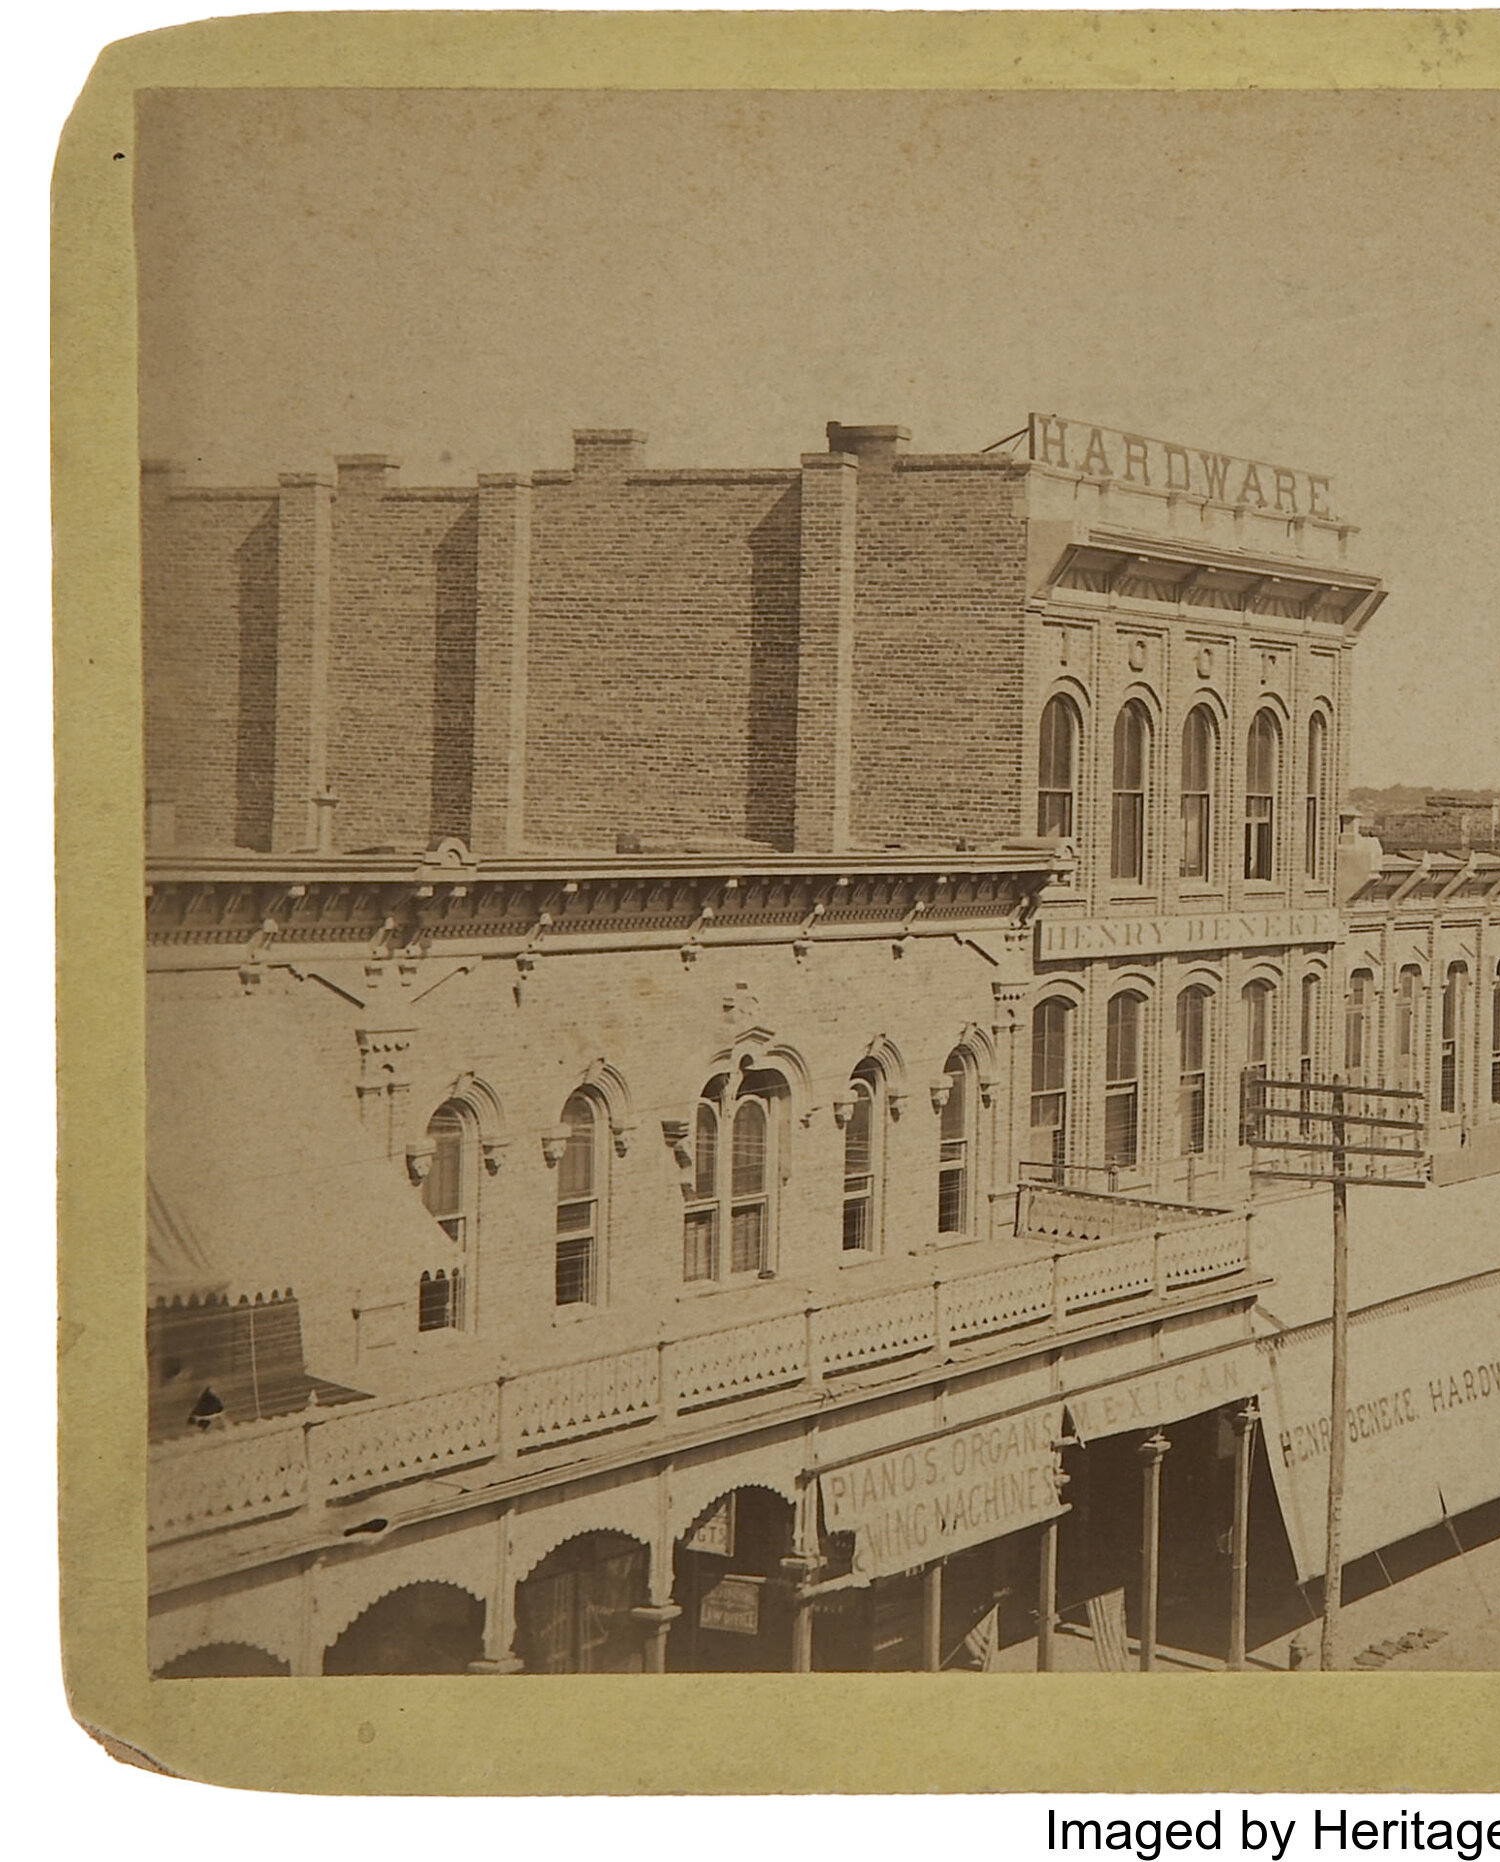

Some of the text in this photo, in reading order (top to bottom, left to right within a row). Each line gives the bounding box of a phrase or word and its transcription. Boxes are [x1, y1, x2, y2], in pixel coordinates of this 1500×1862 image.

[1038, 416, 1334, 518] HARDWARE
[1047, 919, 1168, 951] HENRY
[1278, 1416, 1333, 1469] HENR
